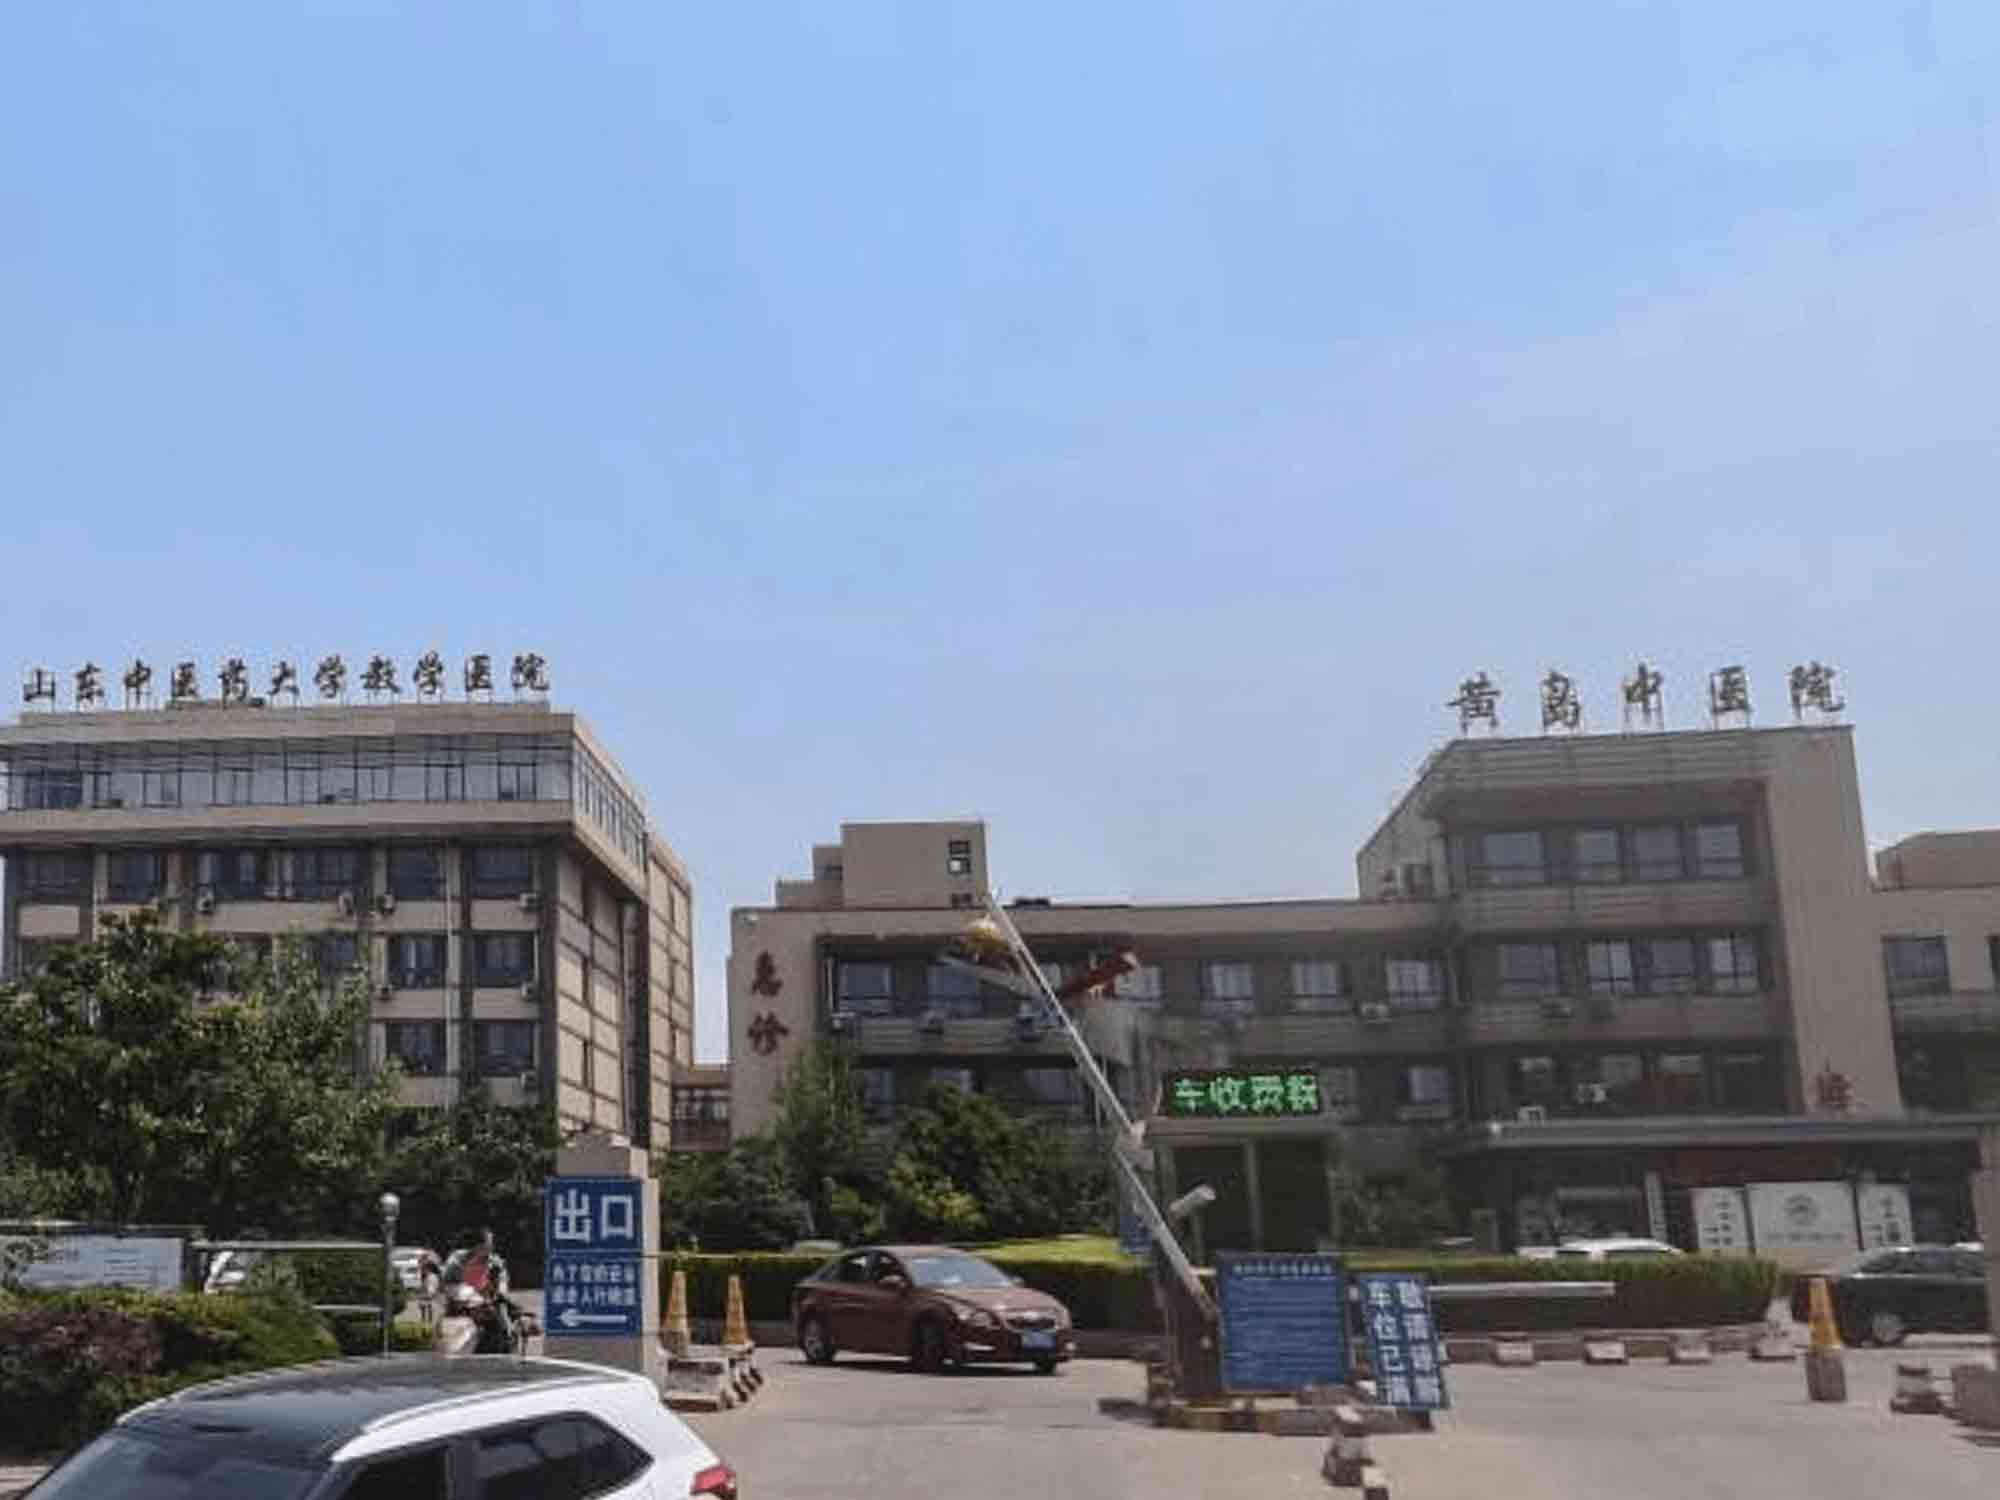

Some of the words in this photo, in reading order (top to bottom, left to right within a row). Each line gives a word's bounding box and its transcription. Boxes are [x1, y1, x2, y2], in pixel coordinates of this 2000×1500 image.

[22, 649, 550, 703] 山东中医药大学教学医院
[1447, 662, 1846, 732] 黄岛中医院
[554, 1188, 635, 1243] 出口
